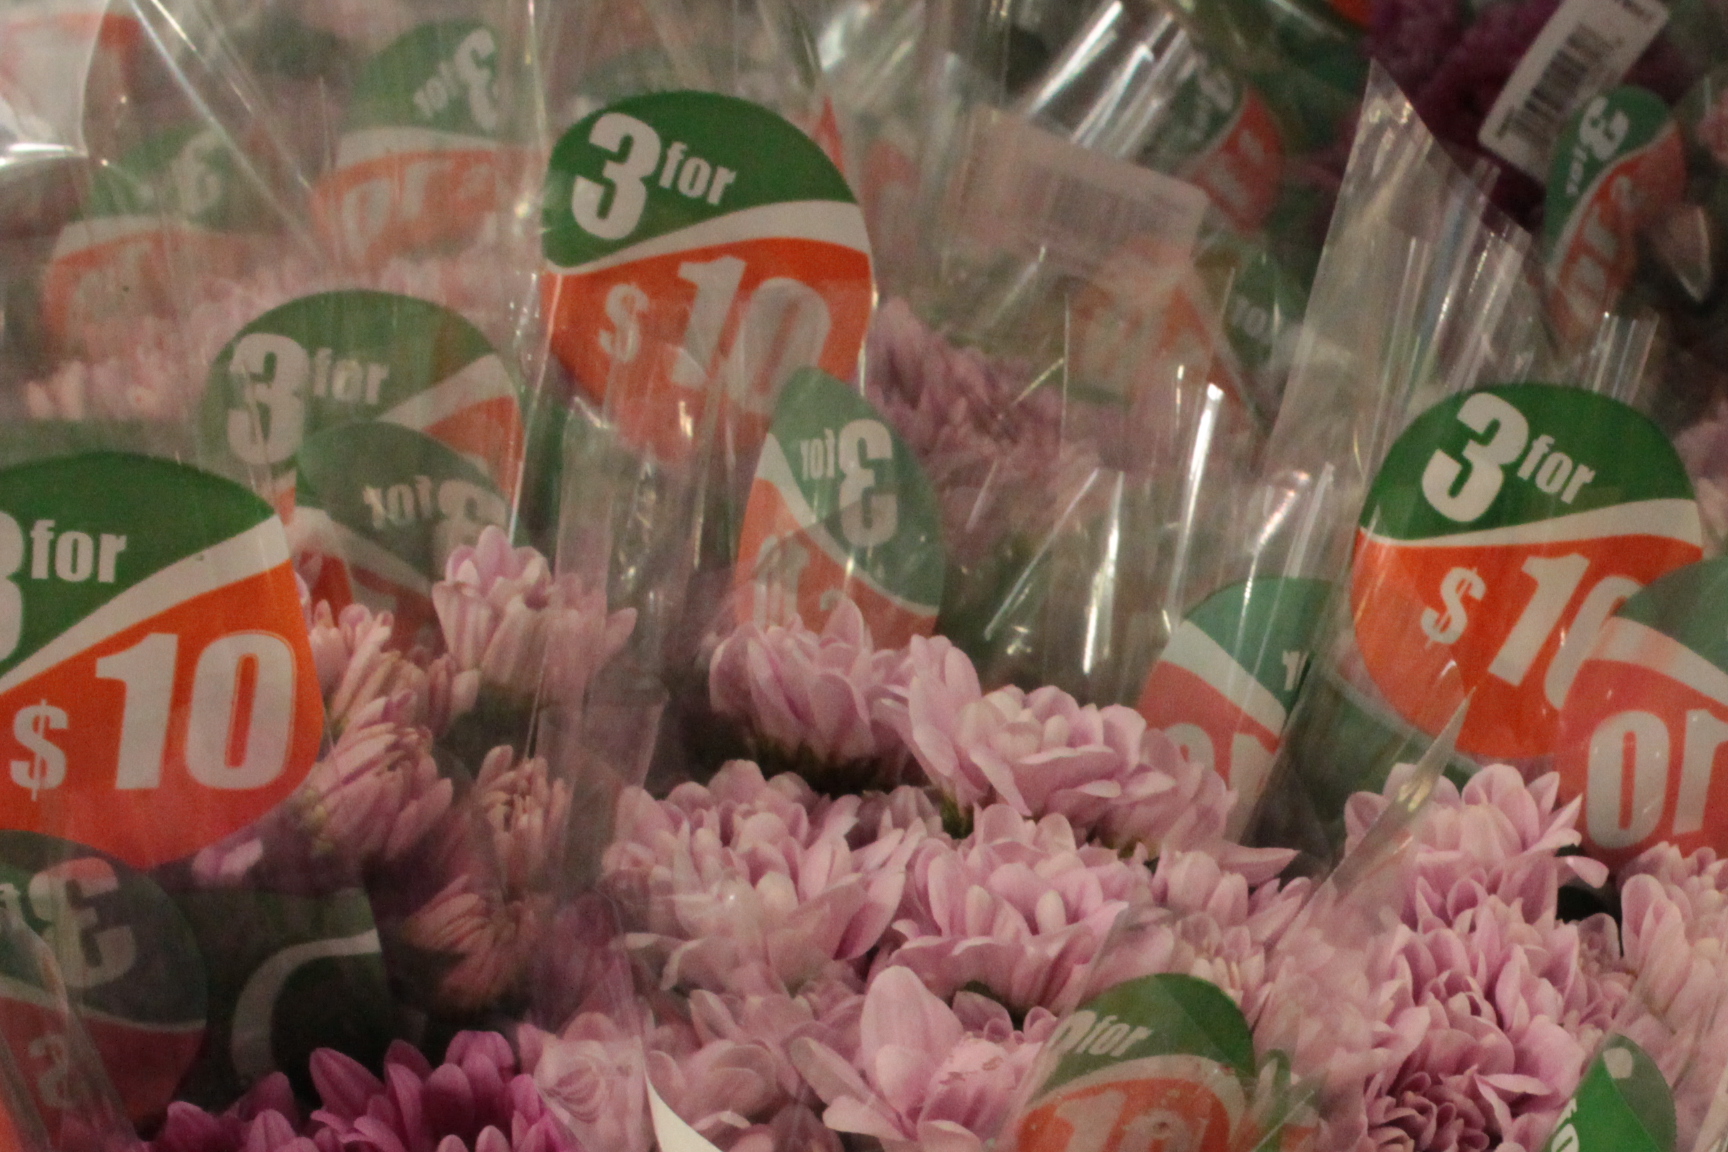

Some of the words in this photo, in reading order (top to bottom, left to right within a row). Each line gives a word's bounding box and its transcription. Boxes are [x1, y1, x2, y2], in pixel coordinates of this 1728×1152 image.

[572, 113, 661, 239] 3
[659, 142, 737, 206] for
[227, 333, 302, 464] 3
[311, 348, 390, 405] for
[1421, 392, 1529, 522] 3
[1517, 434, 1596, 504] for
[30, 520, 126, 582] for
